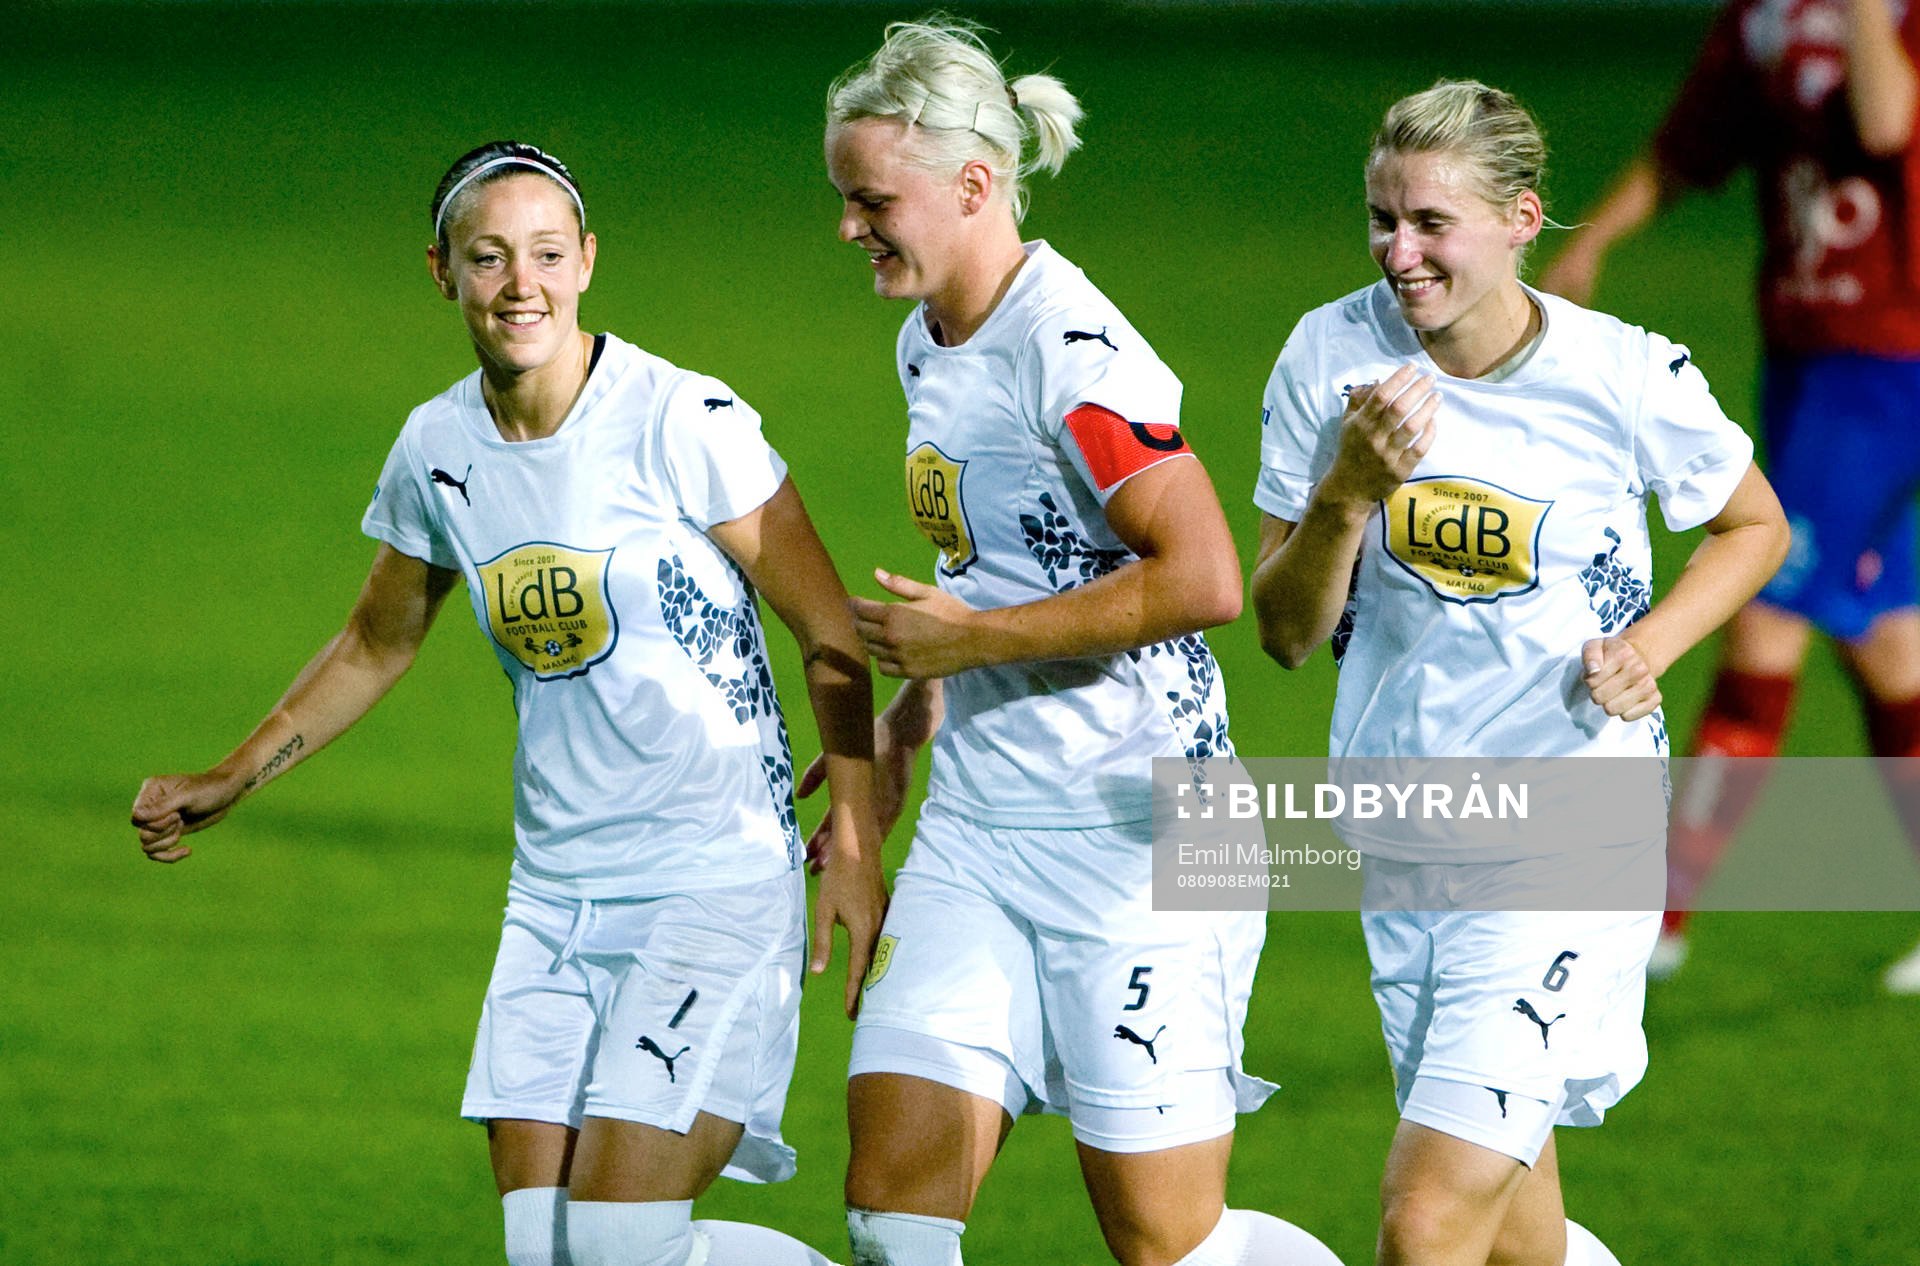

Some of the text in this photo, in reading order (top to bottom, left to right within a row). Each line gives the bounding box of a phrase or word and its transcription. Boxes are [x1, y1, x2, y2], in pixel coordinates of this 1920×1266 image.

[910, 466, 949, 520] LdB
[1432, 487, 1489, 502] Since 2007
[1408, 496, 1511, 558] LdB
[514, 554, 556, 567] Since 2007
[1410, 548, 1510, 571] FOOTBALL CLUB
[498, 566, 584, 624] LdB
[505, 619, 588, 637] FOOTBALL CLUB
[1123, 967, 1153, 1011] 5
[1542, 950, 1579, 992] 6
